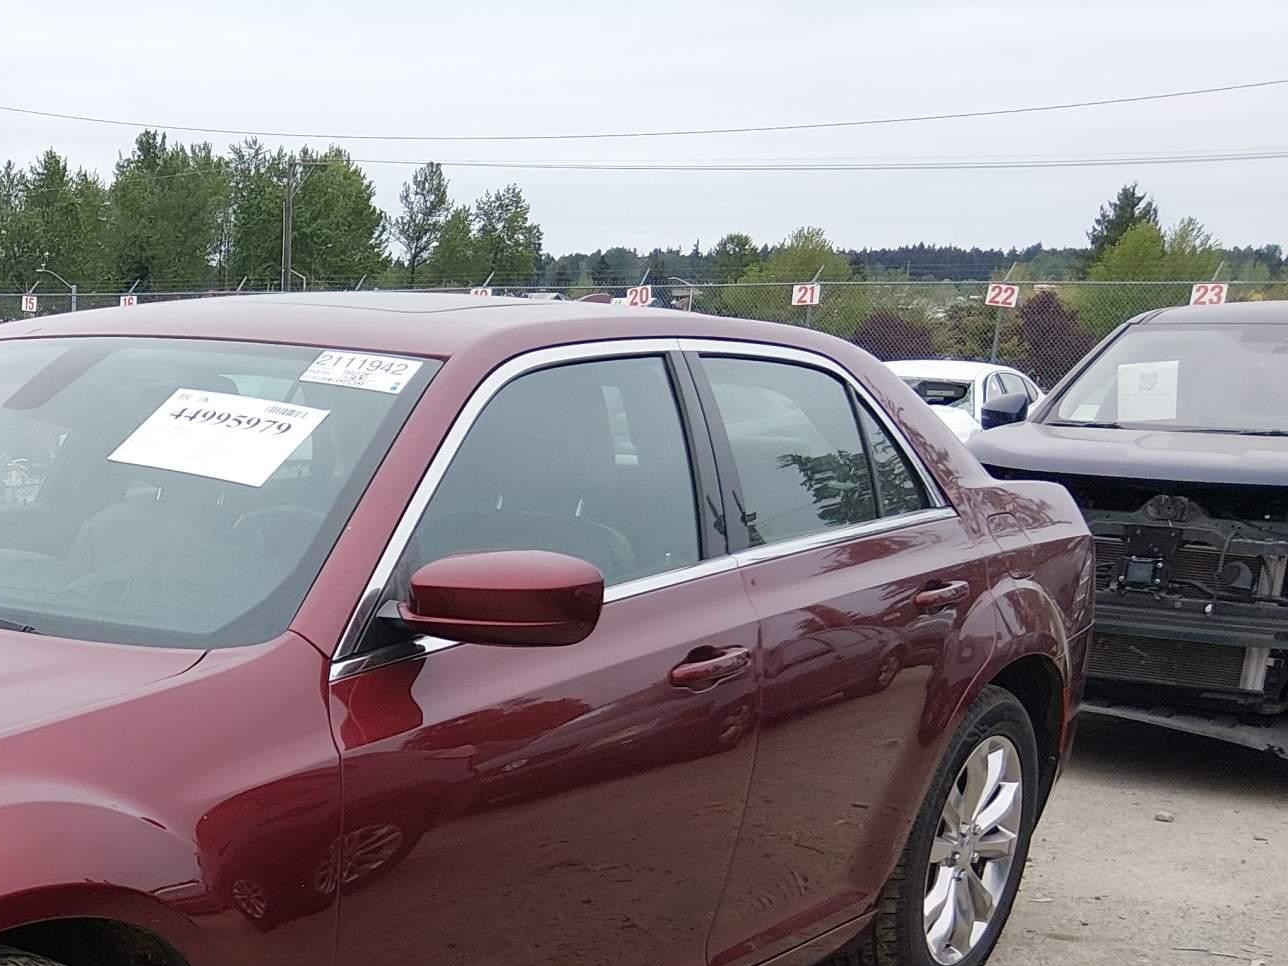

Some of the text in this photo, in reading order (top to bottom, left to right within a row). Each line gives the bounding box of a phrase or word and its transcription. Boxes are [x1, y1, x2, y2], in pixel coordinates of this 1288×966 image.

[25, 297, 34, 310] 15
[629, 287, 649, 306] 20
[797, 286, 815, 304] 21
[987, 285, 1016, 306] 22
[1193, 284, 1224, 305] 23
[316, 354, 409, 376] 2111942
[170, 407, 293, 436] 44995979
